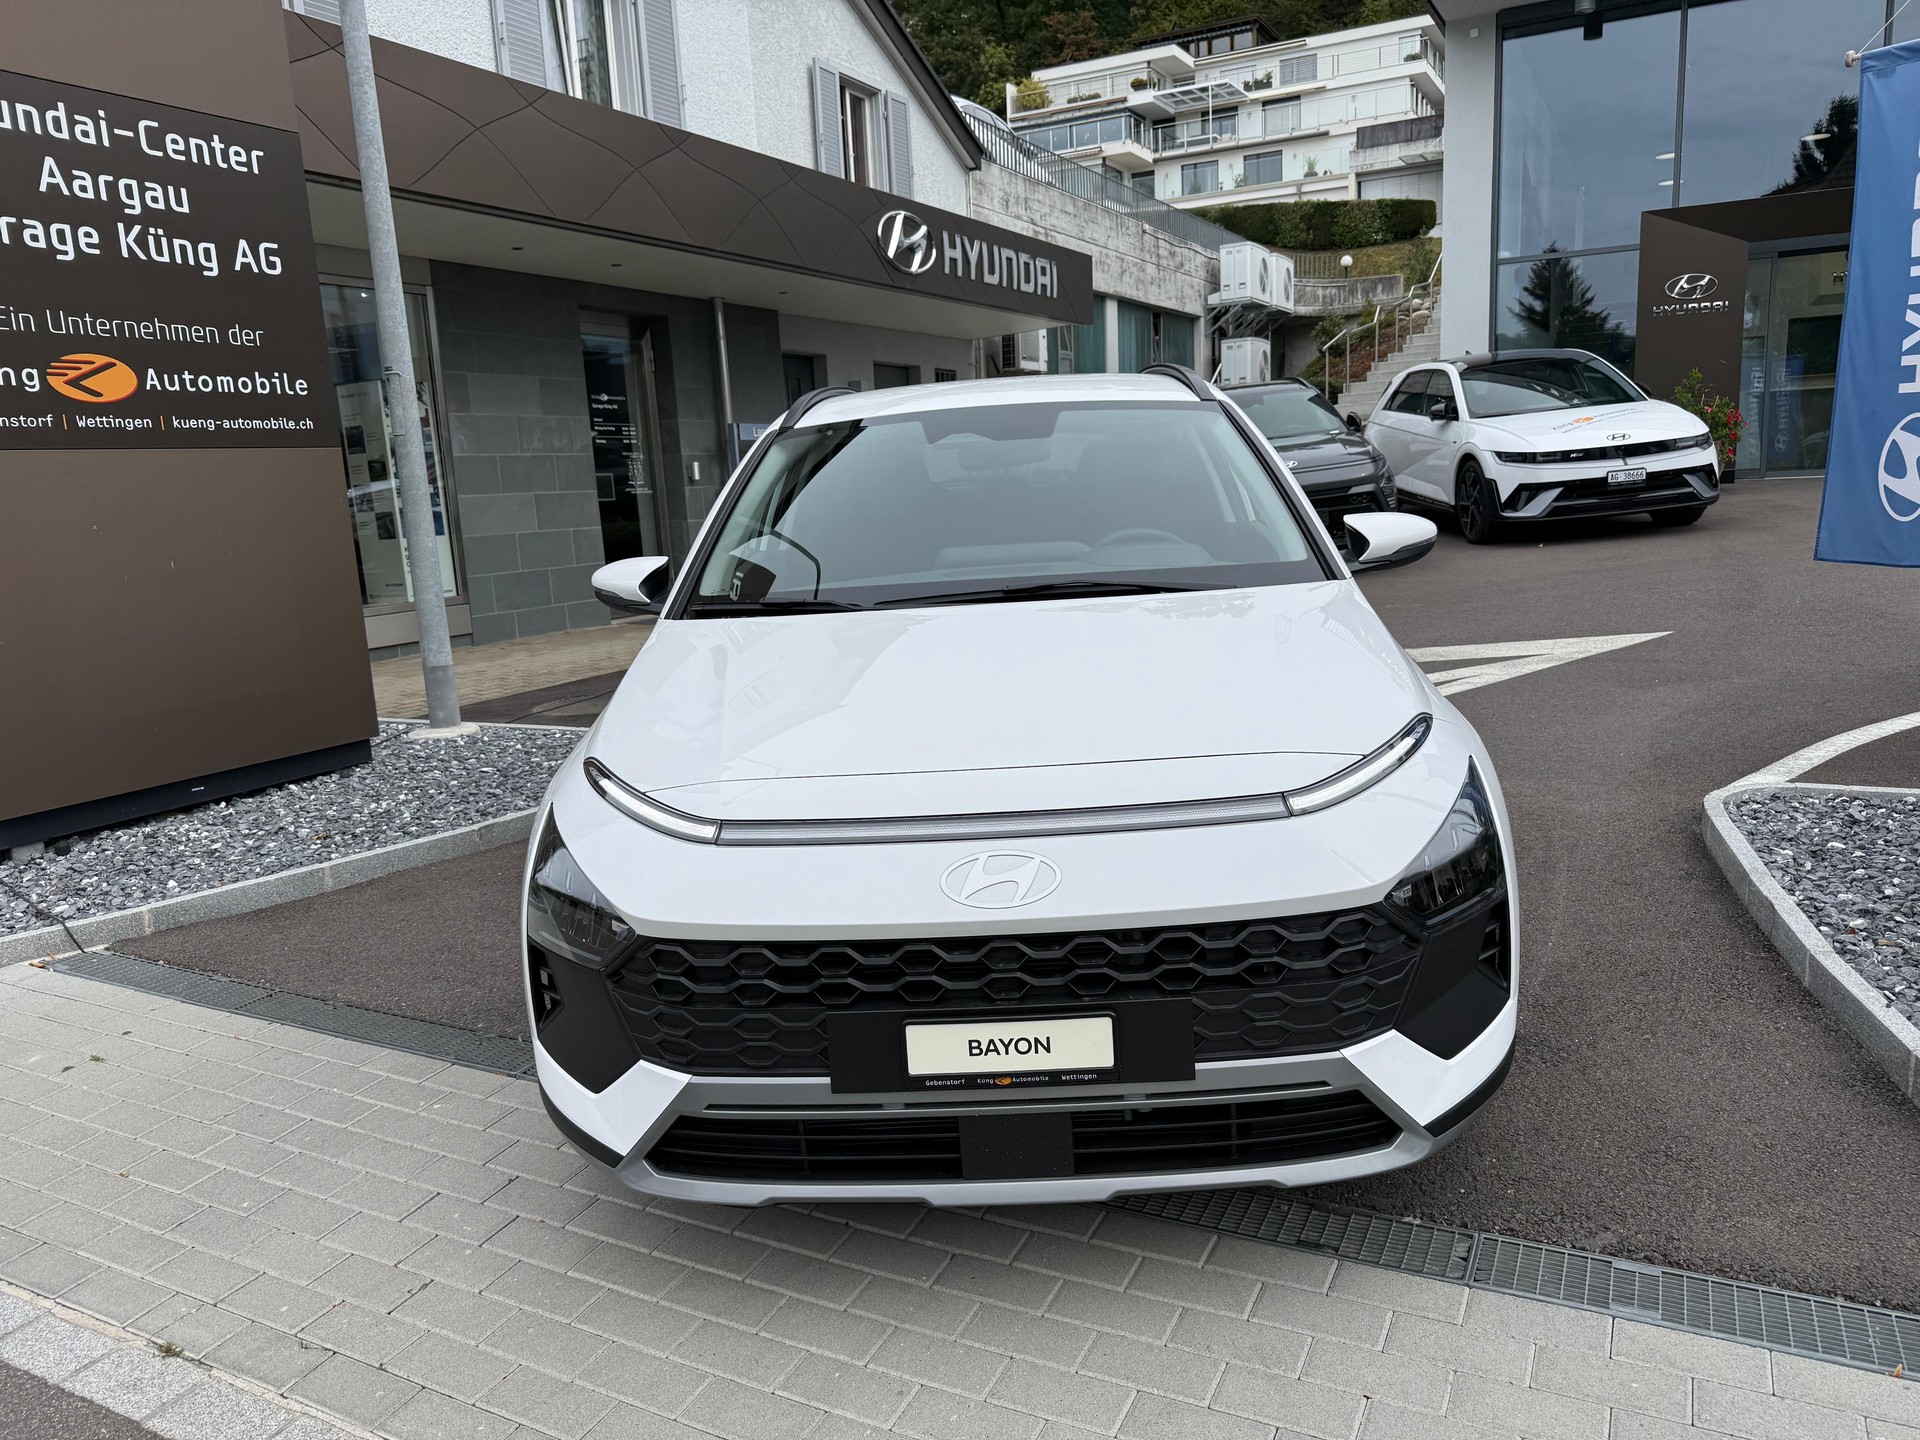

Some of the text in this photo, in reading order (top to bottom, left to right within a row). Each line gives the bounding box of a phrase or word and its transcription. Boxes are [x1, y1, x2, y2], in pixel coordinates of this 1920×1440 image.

[38, 155, 190, 215] Aargau
[0, 215, 282, 277] rage Küng AG
[942, 230, 1058, 299] HYUNDAI
[1652, 300, 1729, 317] HYUNDAI
[46, 308, 220, 344] Unternehmen
[228, 322, 264, 347] der
[145, 367, 309, 396] Automobile
[75, 414, 152, 429] Wettingen
[172, 415, 314, 431] kueng-automobile.ch
[968, 1036, 1051, 1057] BAYON
[925, 1078, 966, 1086] Gebenstorf
